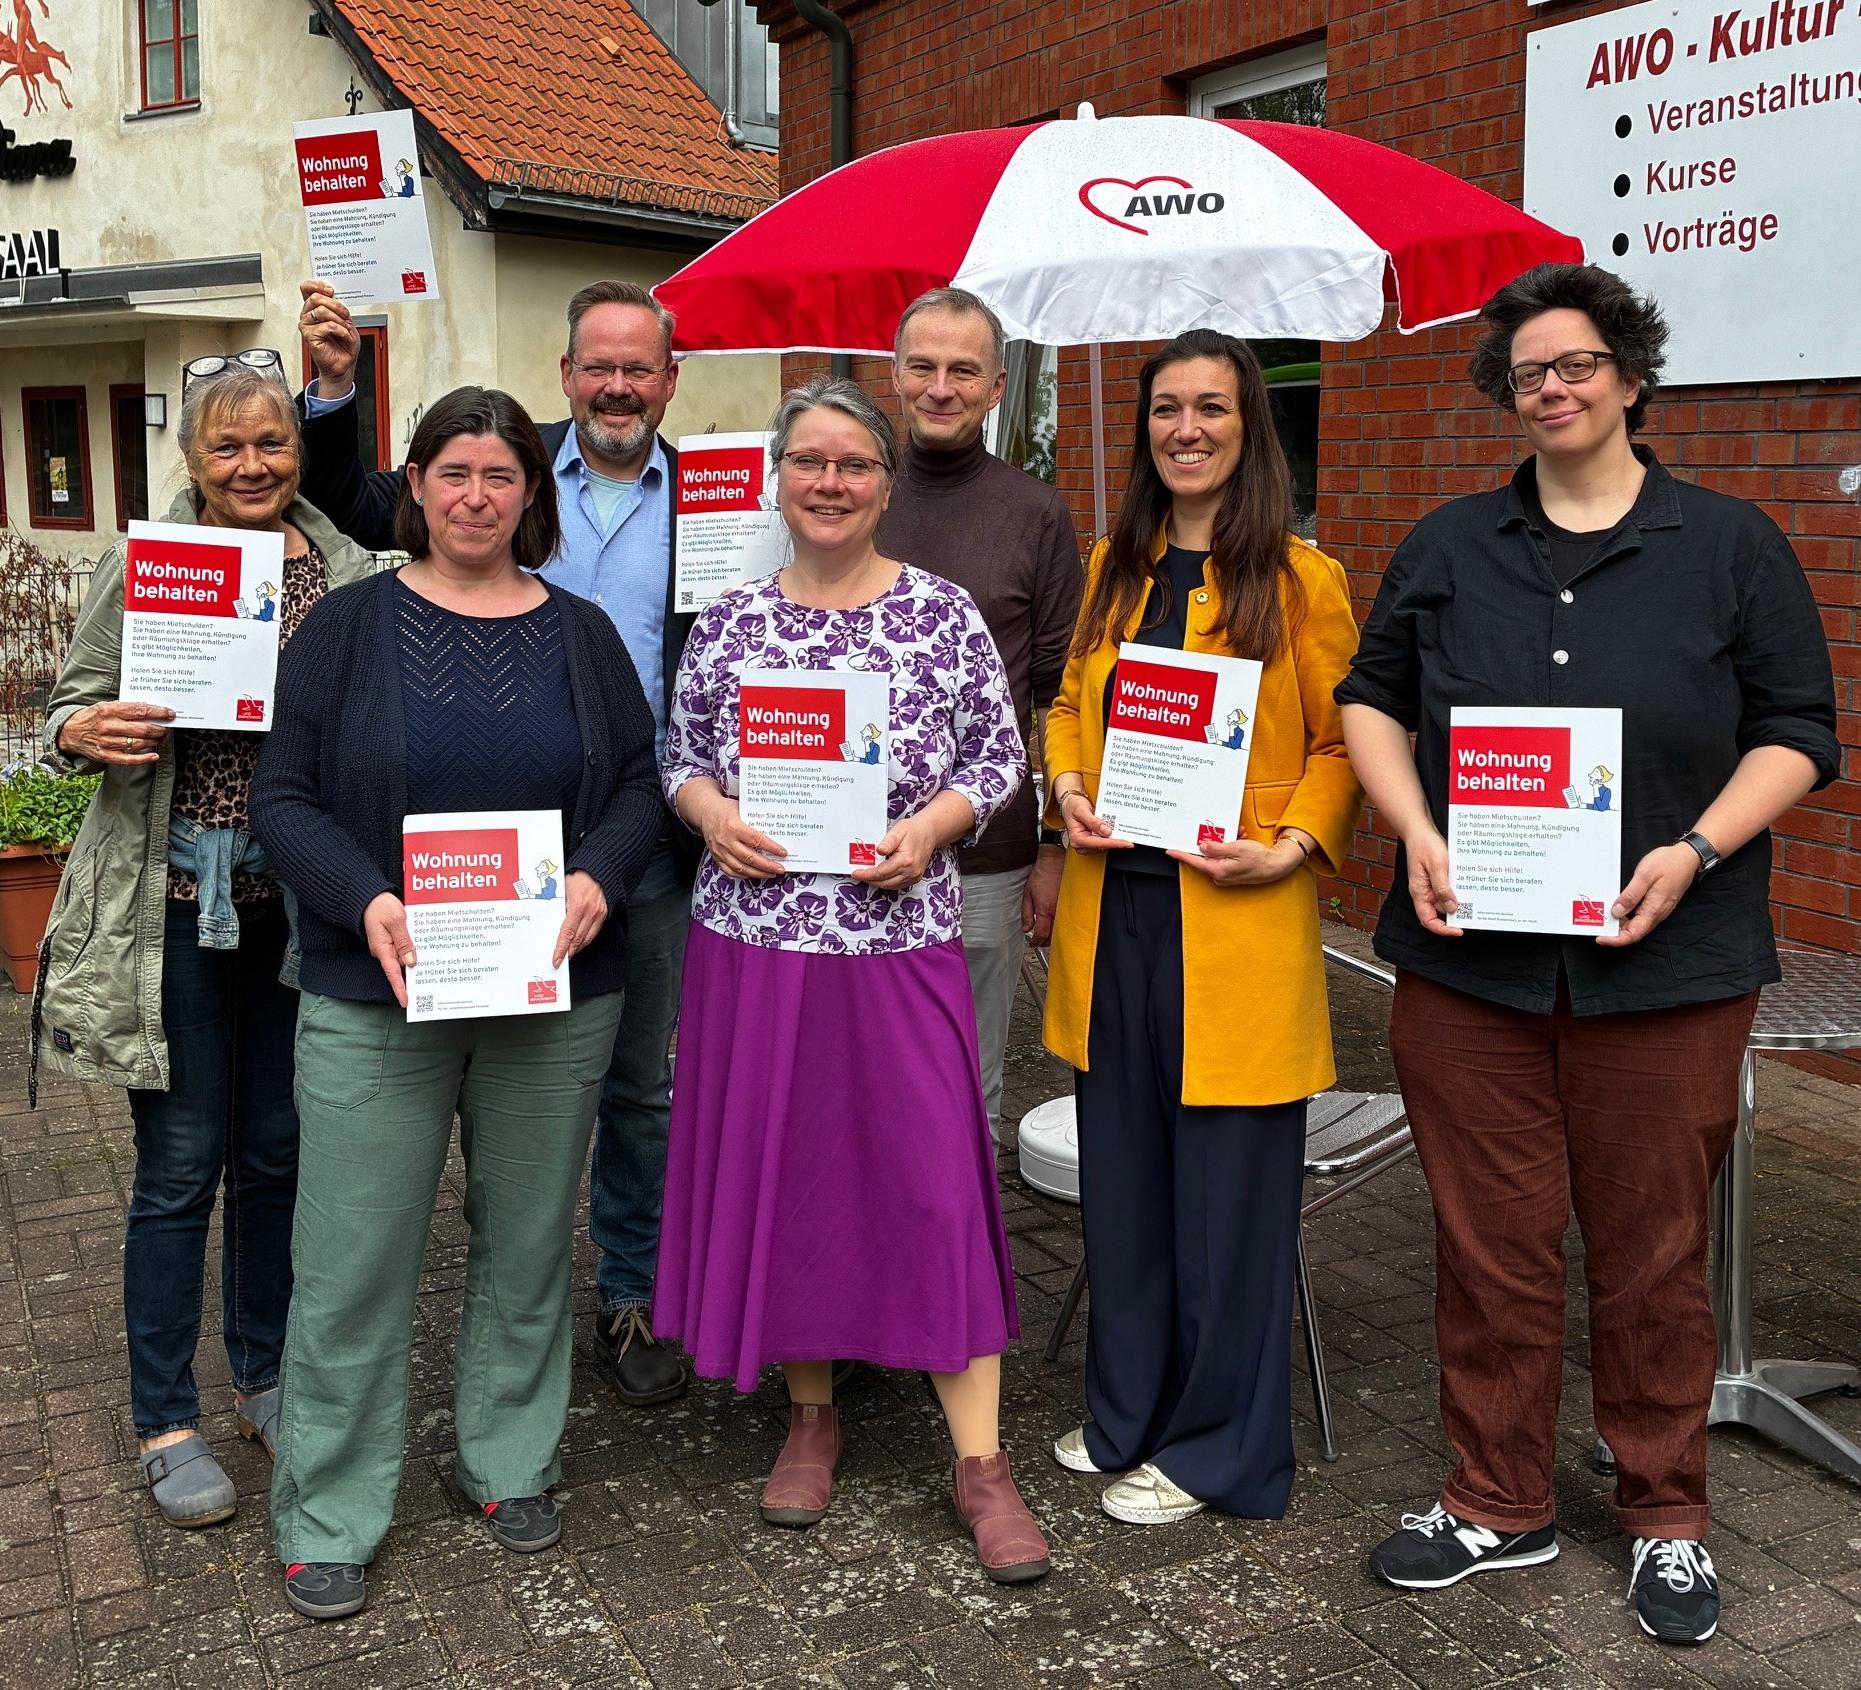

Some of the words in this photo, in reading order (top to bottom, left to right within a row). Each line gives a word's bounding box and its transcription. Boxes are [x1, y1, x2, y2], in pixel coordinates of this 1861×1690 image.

[1586, 27, 1674, 89] AWO
[1708, 0, 1845, 64] Kultur
[1647, 71, 1861, 135] Veranstaltun
[301, 154, 369, 173] Wohnung
[304, 174, 367, 193] behalten
[1647, 156, 1737, 195] Kurse
[1123, 192, 1225, 218] AWO
[1644, 210, 1779, 255] Vorträge
[682, 468, 750, 484] Wohnung
[682, 485, 745, 502] behalten
[135, 560, 225, 586] Wohnung
[134, 582, 218, 603] behalten
[1120, 680, 1199, 709] Wohnung
[746, 707, 830, 730] Wohnung
[1116, 701, 1191, 726] behalten
[746, 729, 825, 747] behalten
[1457, 748, 1552, 772] Wohnung
[1457, 772, 1545, 792] behalten
[411, 852, 502, 870] Wohnung
[412, 873, 497, 891] behalten
